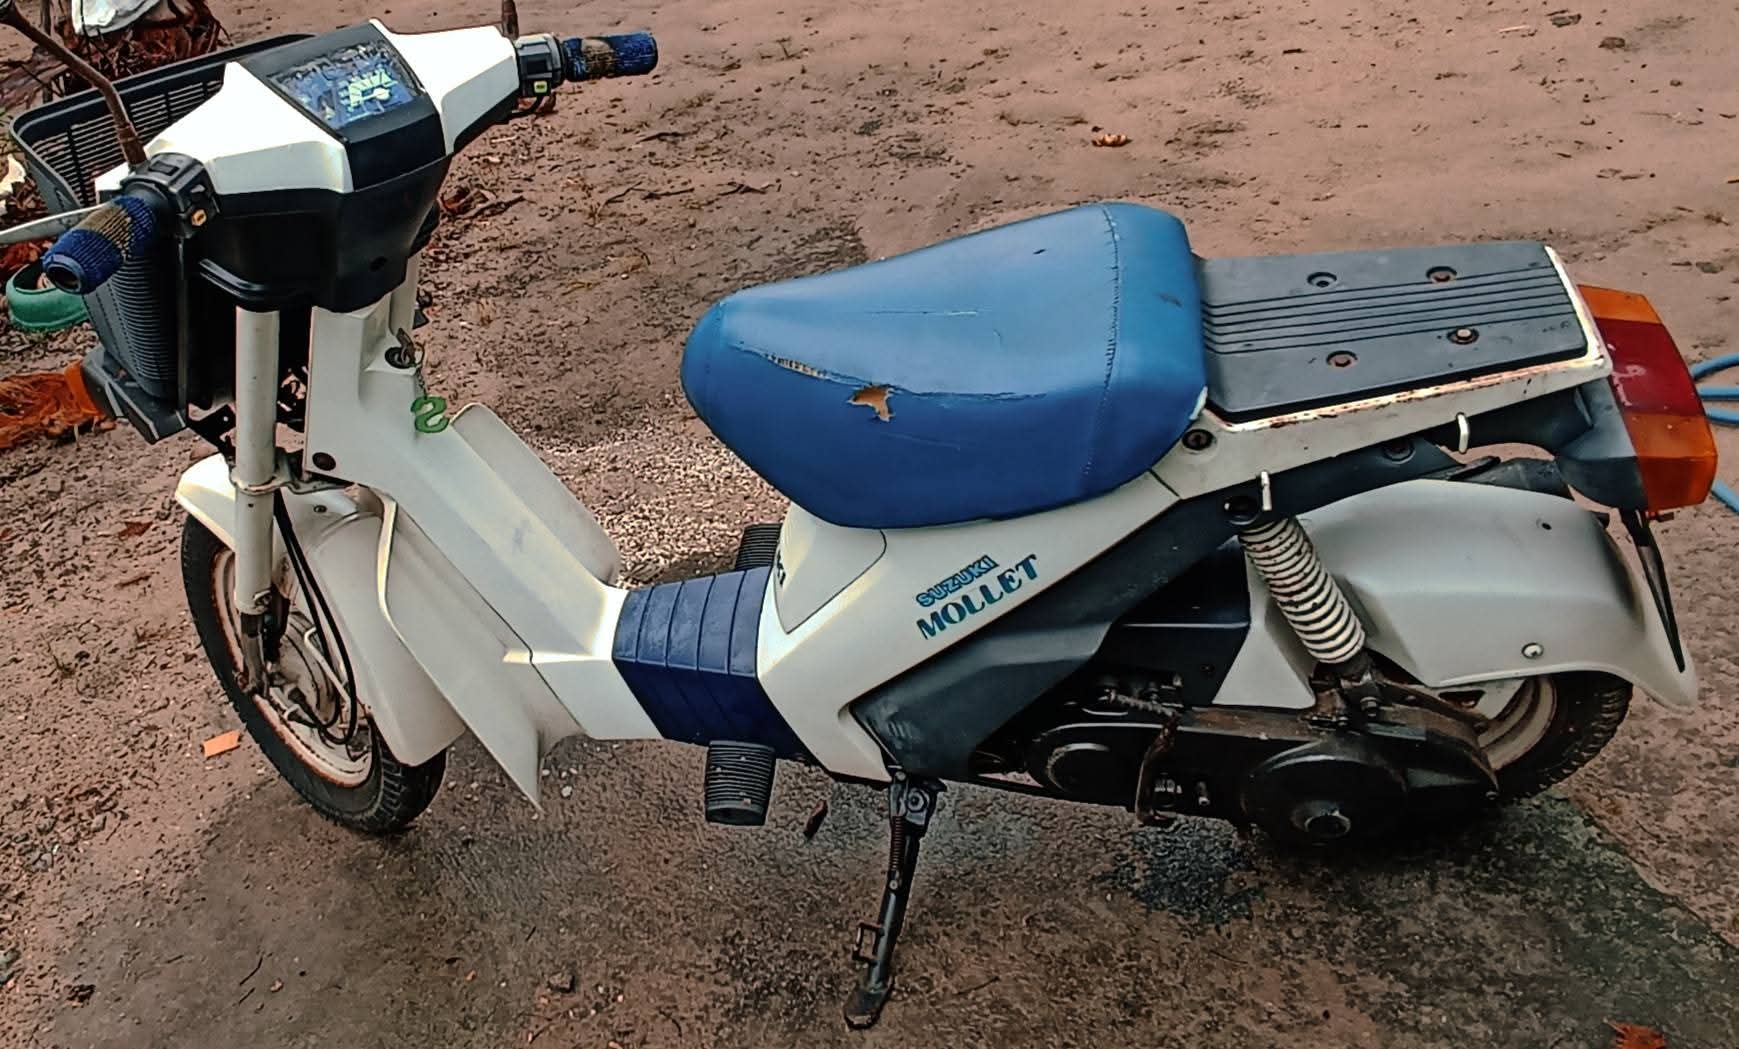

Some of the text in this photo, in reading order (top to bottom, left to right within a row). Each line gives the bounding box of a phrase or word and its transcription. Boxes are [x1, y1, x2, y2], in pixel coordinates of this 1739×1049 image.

[411, 396, 449, 433] S
[916, 555, 999, 607] SUZUKI
[916, 554, 1037, 640] MOLLET
